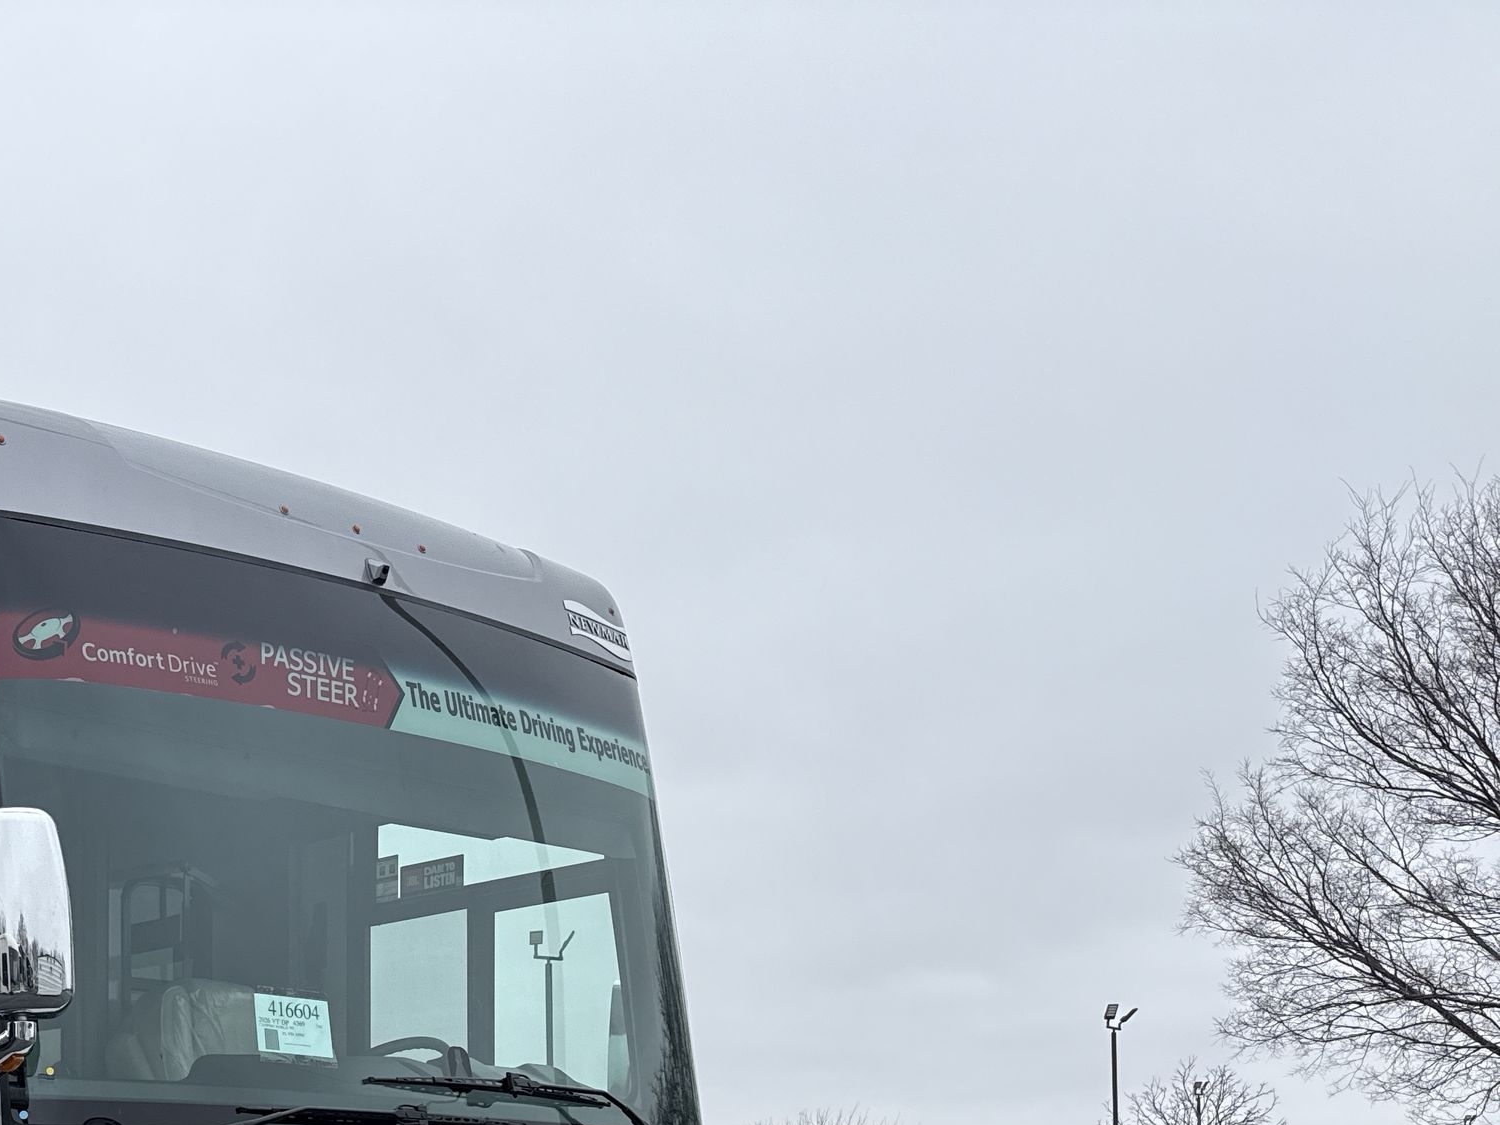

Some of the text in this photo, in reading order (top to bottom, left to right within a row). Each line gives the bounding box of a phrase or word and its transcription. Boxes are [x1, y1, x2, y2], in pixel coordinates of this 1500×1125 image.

[82, 642, 165, 670] Comfort
[260, 641, 355, 682] PASSIVE
[184, 675, 219, 687] STEERING
[287, 672, 360, 709] STEER
[405, 680, 442, 713] The
[443, 689, 518, 732] Ultimate
[518, 709, 577, 753] Driving
[267, 1000, 320, 1021] 416604
